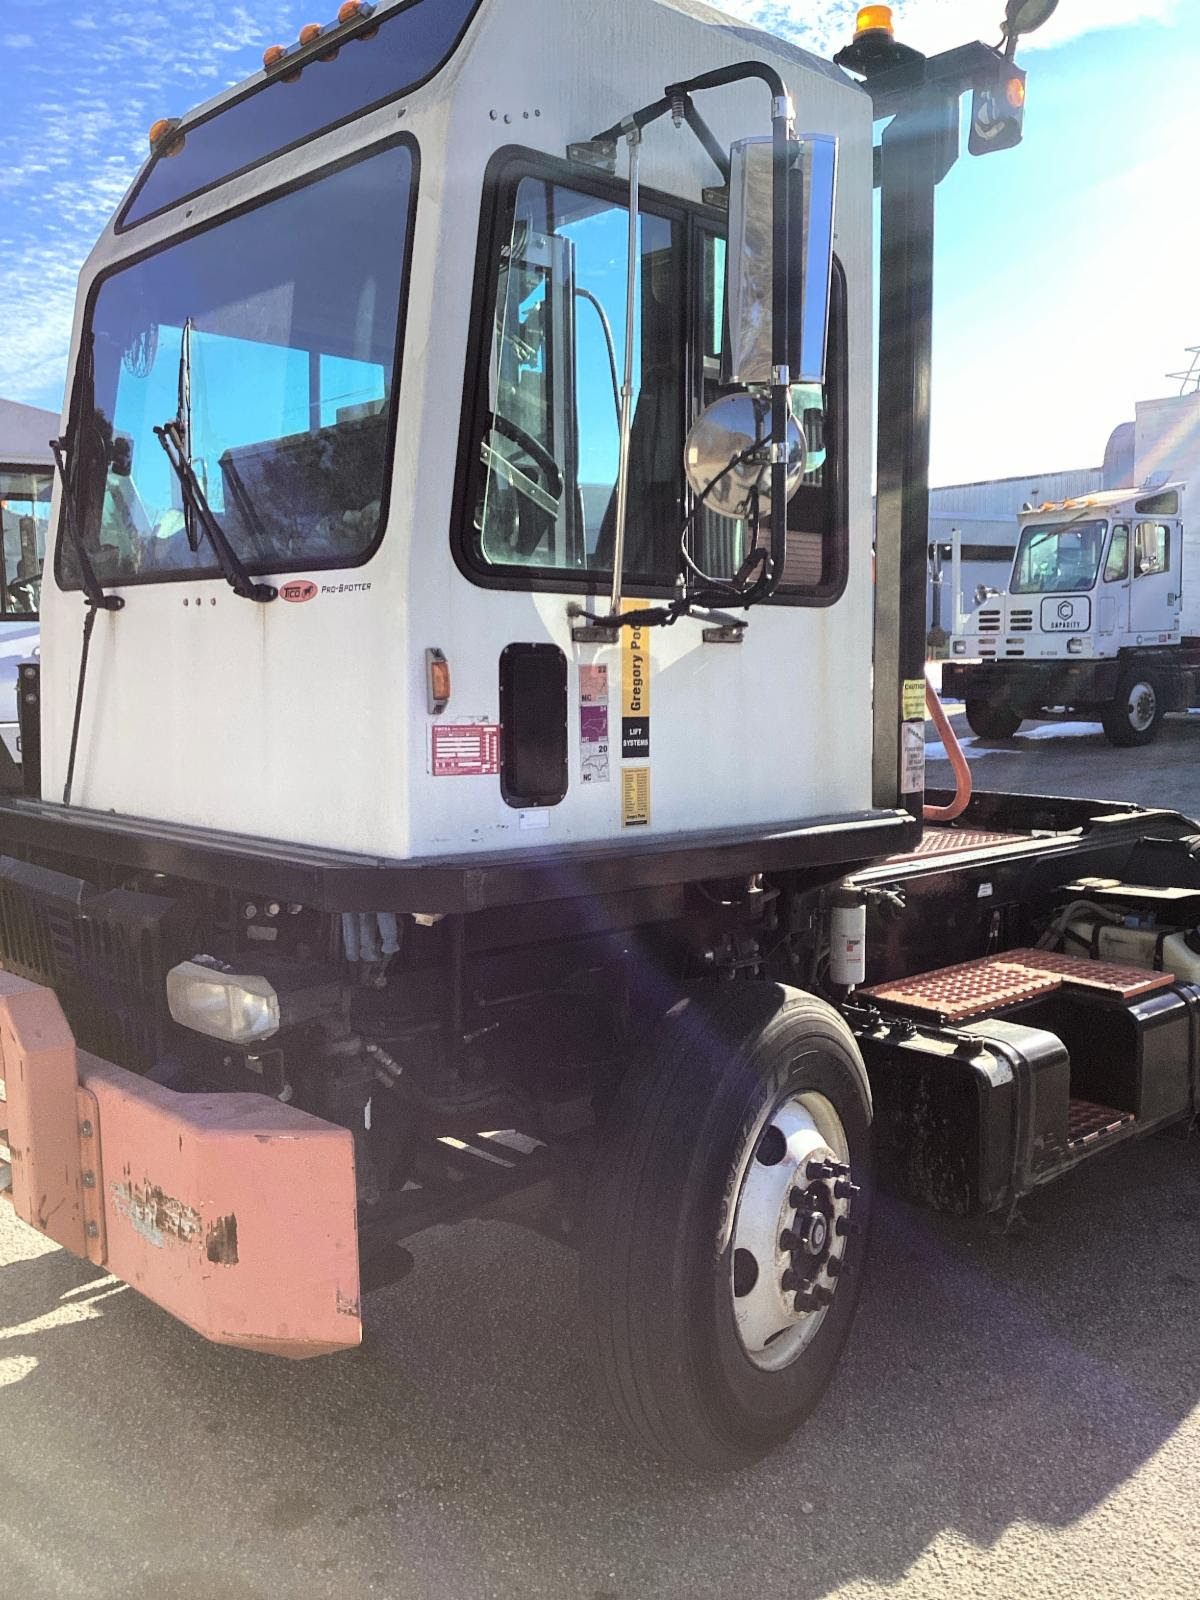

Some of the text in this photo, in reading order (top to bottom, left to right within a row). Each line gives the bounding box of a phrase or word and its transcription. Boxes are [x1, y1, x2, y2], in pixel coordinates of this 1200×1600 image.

[284, 586, 300, 598] TICO
[1050, 621, 1081, 629] CAPACITY
[630, 622, 644, 711] Gregory Poo
[629, 728, 642, 736] LIFT
[623, 739, 649, 747] SYSTEMS
[598, 745, 608, 753] 20
[583, 773, 592, 781] NC
